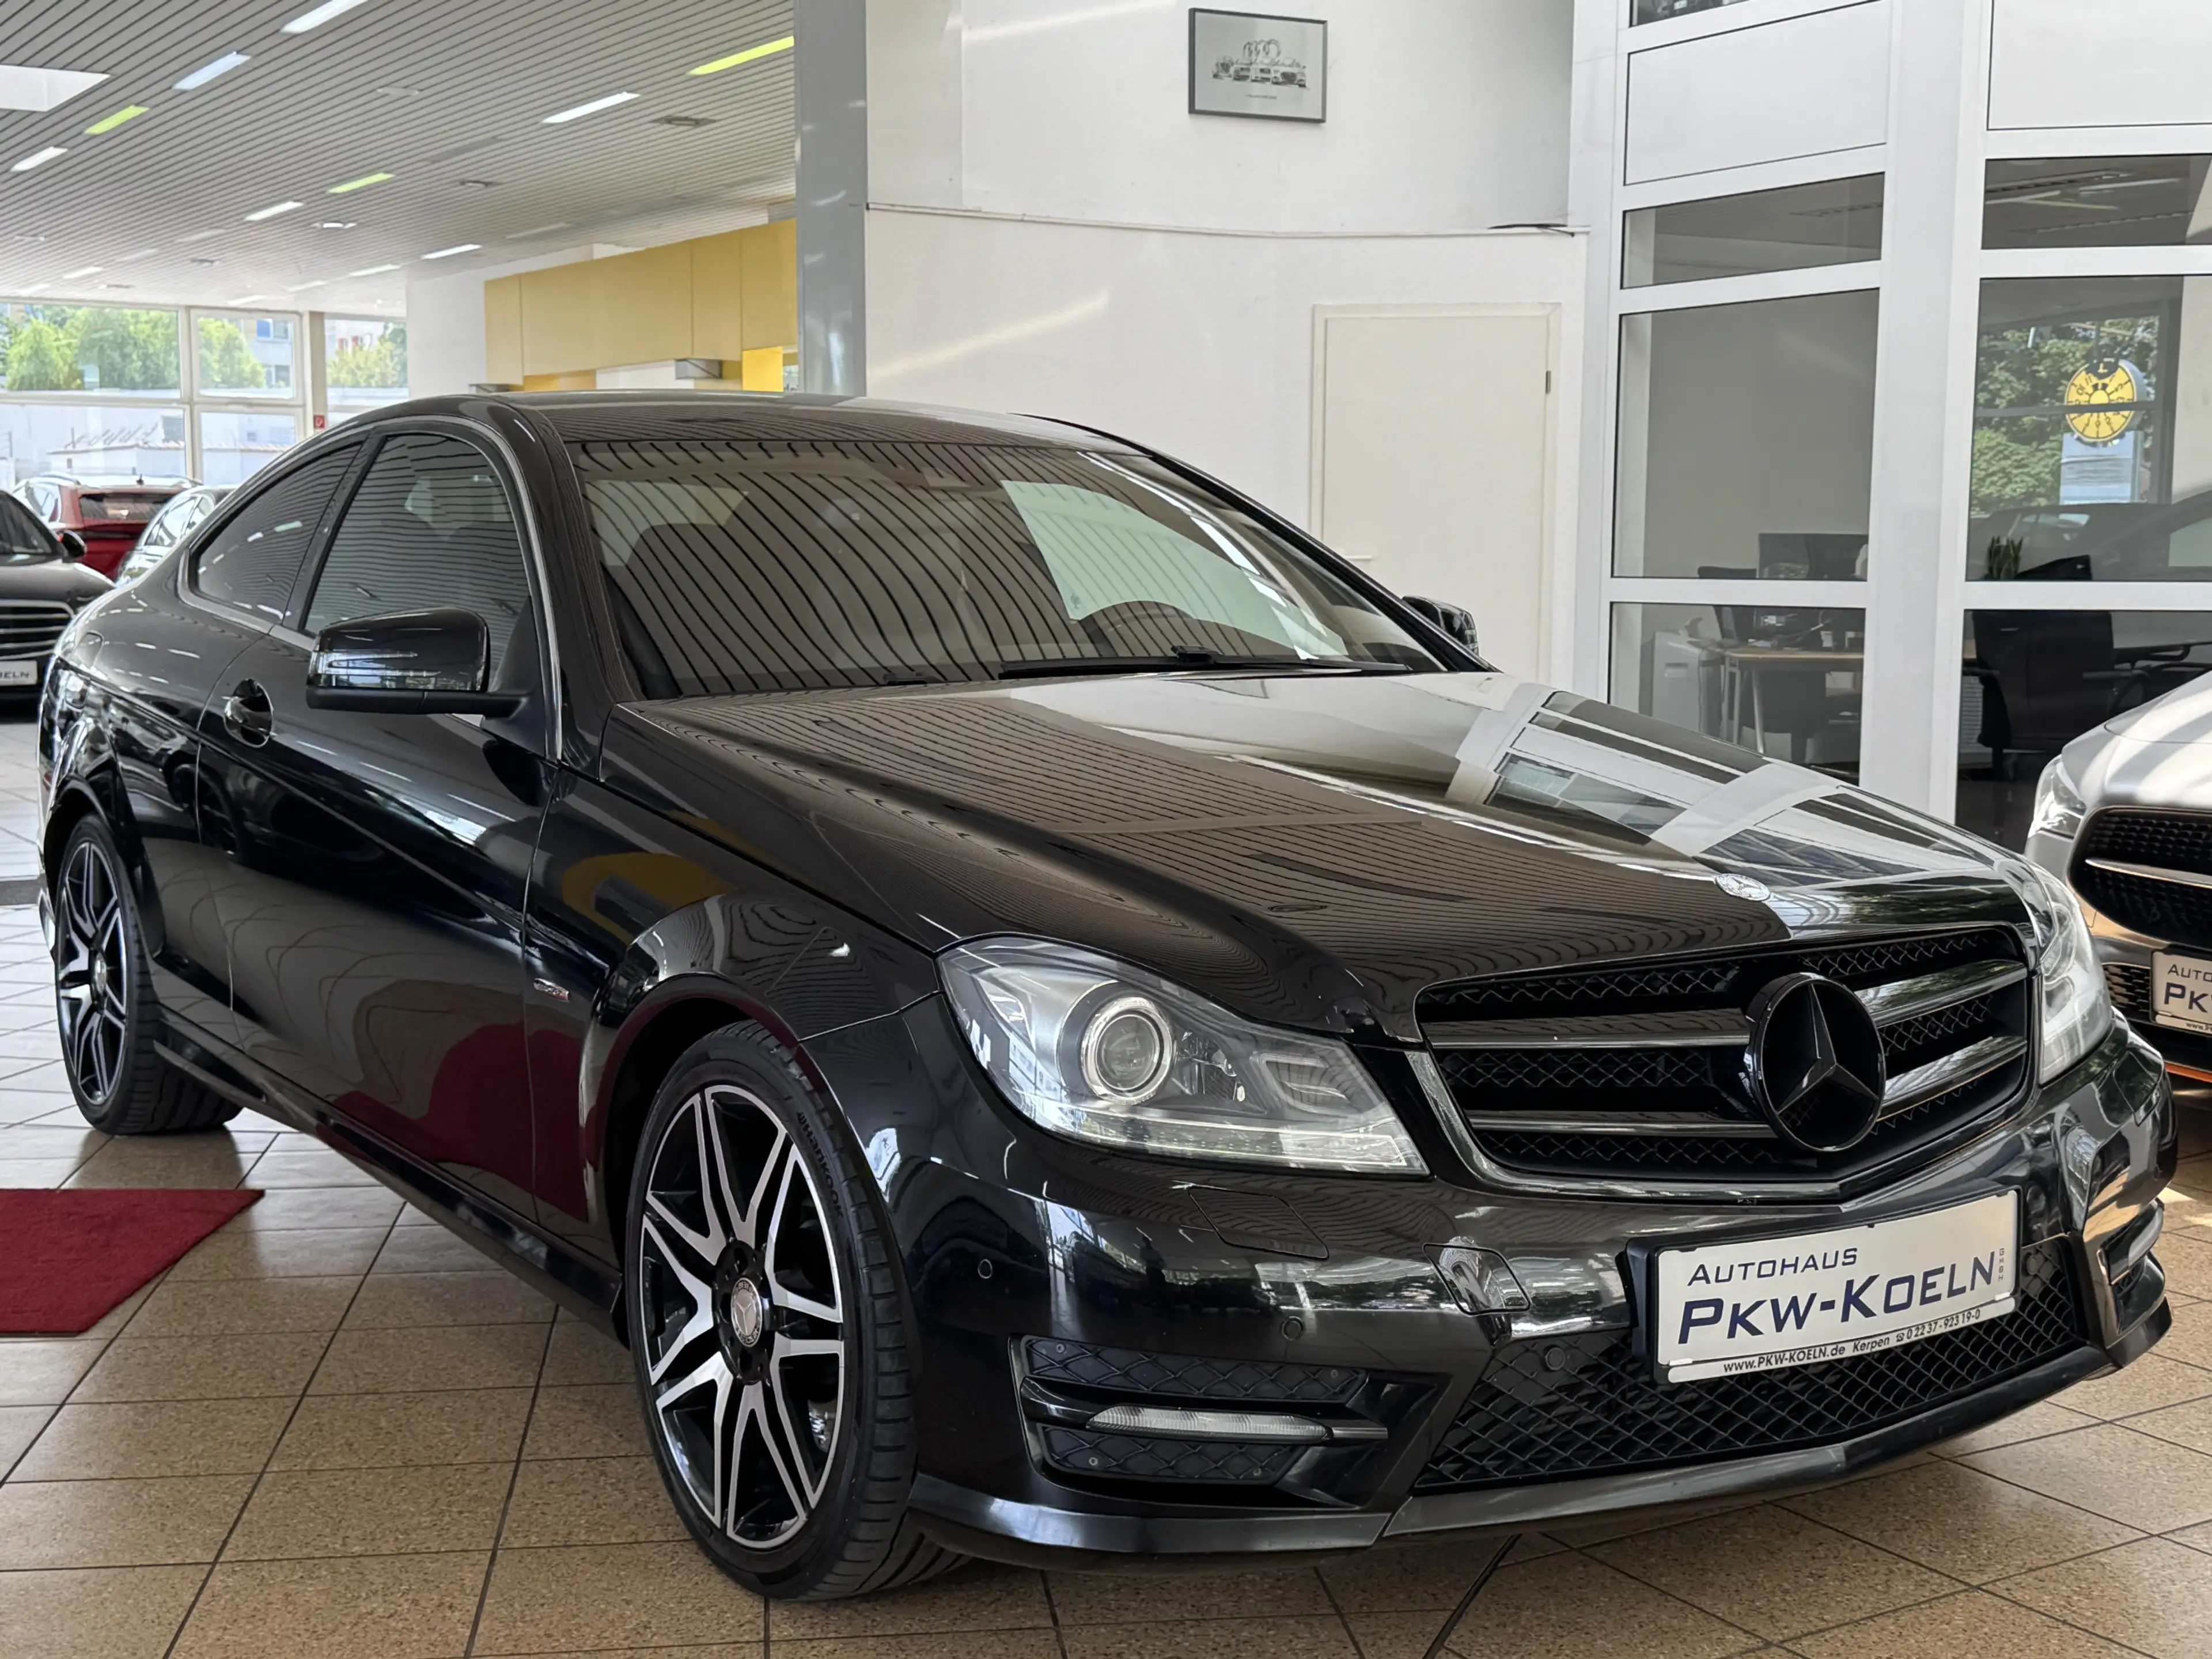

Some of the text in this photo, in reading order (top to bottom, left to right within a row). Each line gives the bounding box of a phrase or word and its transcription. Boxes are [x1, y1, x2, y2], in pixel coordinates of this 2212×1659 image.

[2164, 982, 2212, 1013] PK
[1687, 1247, 1858, 1286] AUTOHAUS
[1677, 1251, 1995, 1344] PKW-KOELN
[1724, 1343, 1846, 1373] www.PKW-KOELN.de
[1852, 1336, 1890, 1353] Kerpen
